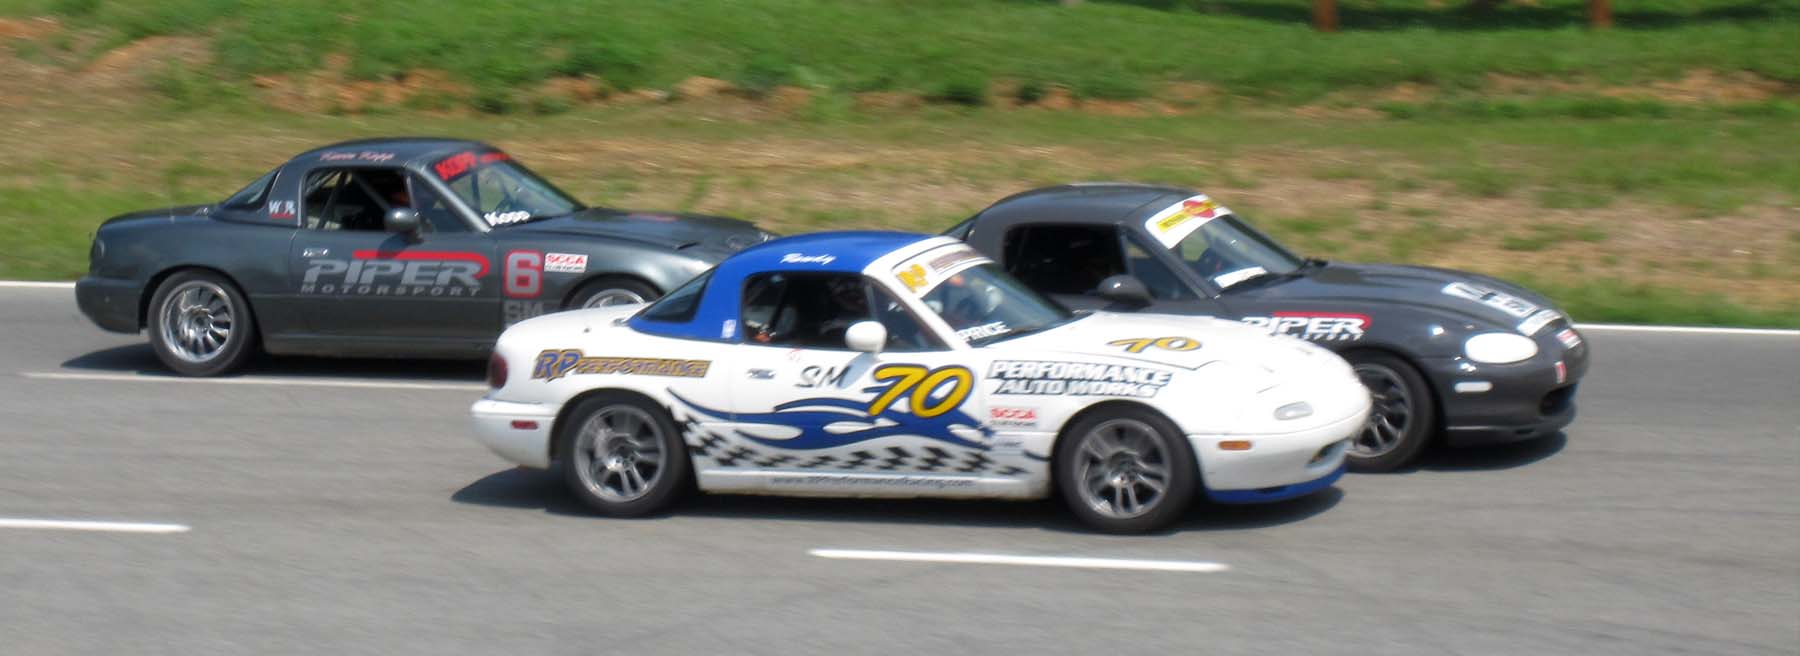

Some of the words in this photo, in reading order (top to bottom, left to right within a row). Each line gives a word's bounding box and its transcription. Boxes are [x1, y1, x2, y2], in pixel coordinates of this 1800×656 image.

[302, 258, 483, 287] PIPER
[504, 250, 542, 298] 6
[301, 284, 481, 297] MOTORSPORT
[1241, 316, 1366, 337] PIPER
[1104, 336, 1203, 354] 70
[794, 365, 852, 389] SM
[986, 360, 1174, 387] PERFORMANCE
[867, 363, 975, 419] 70
[992, 379, 1064, 396] AUTO
[1066, 380, 1161, 399] WORKS
